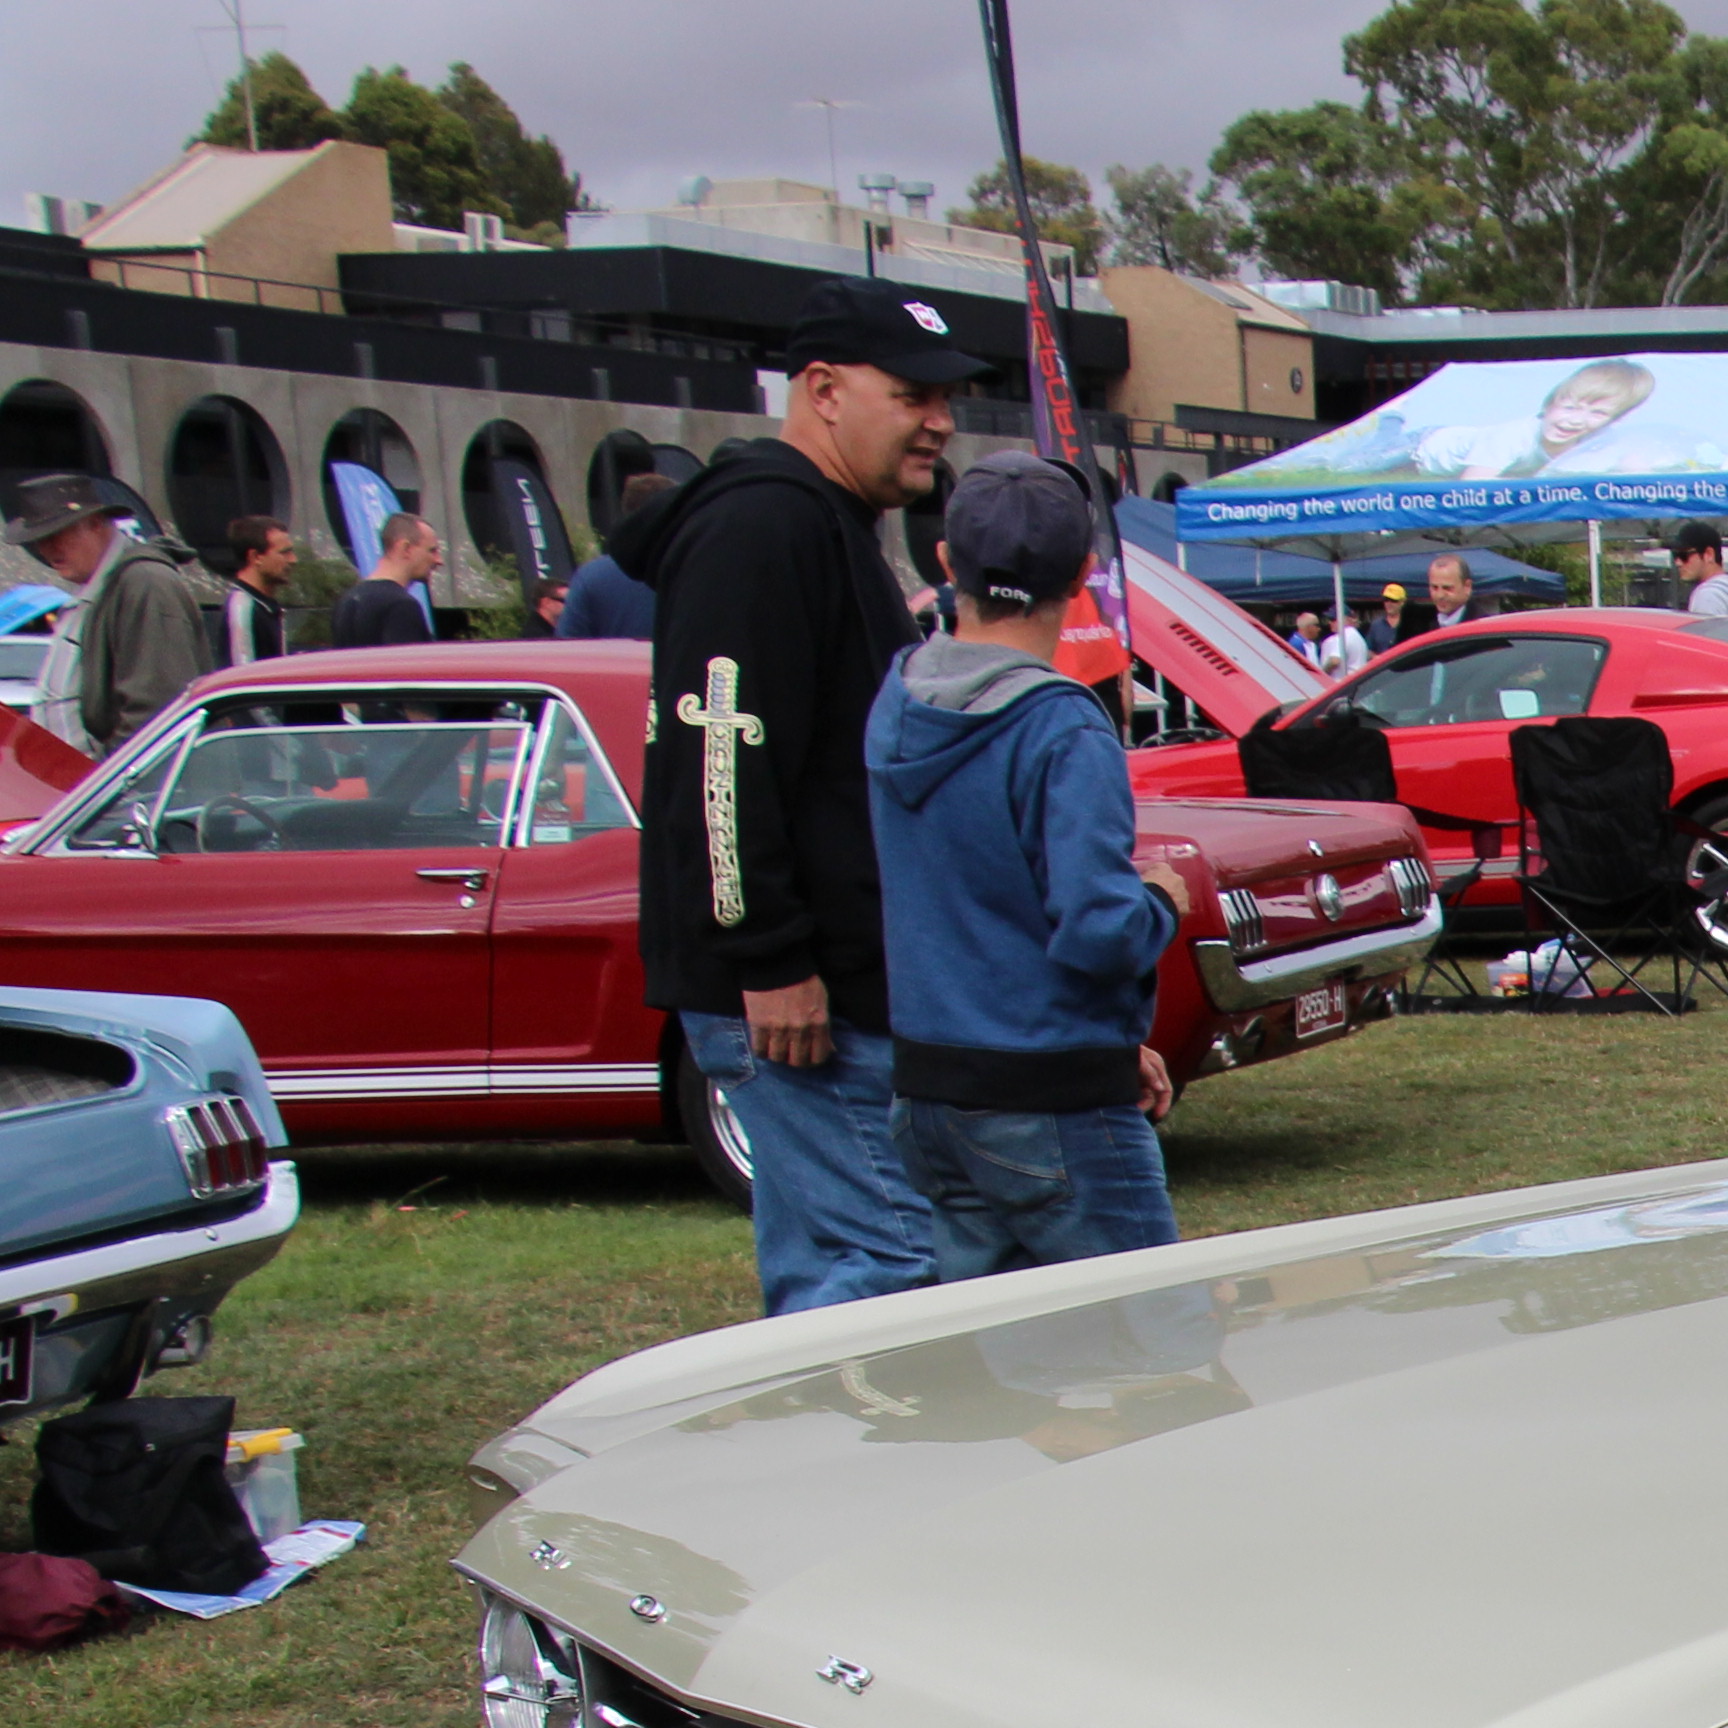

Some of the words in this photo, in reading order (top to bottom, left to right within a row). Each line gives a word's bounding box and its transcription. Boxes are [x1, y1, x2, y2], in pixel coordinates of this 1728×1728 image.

[1207, 502, 1298, 523] Changing
[1304, 497, 1335, 516] the
[1341, 492, 1394, 513] world
[1401, 493, 1436, 509] one
[1442, 487, 1488, 507] child
[1493, 487, 1513, 505] at
[1518, 489, 1532, 503] a
[1536, 484, 1588, 502] time.
[1595, 481, 1687, 502] Changing
[1694, 480, 1726, 498] the
